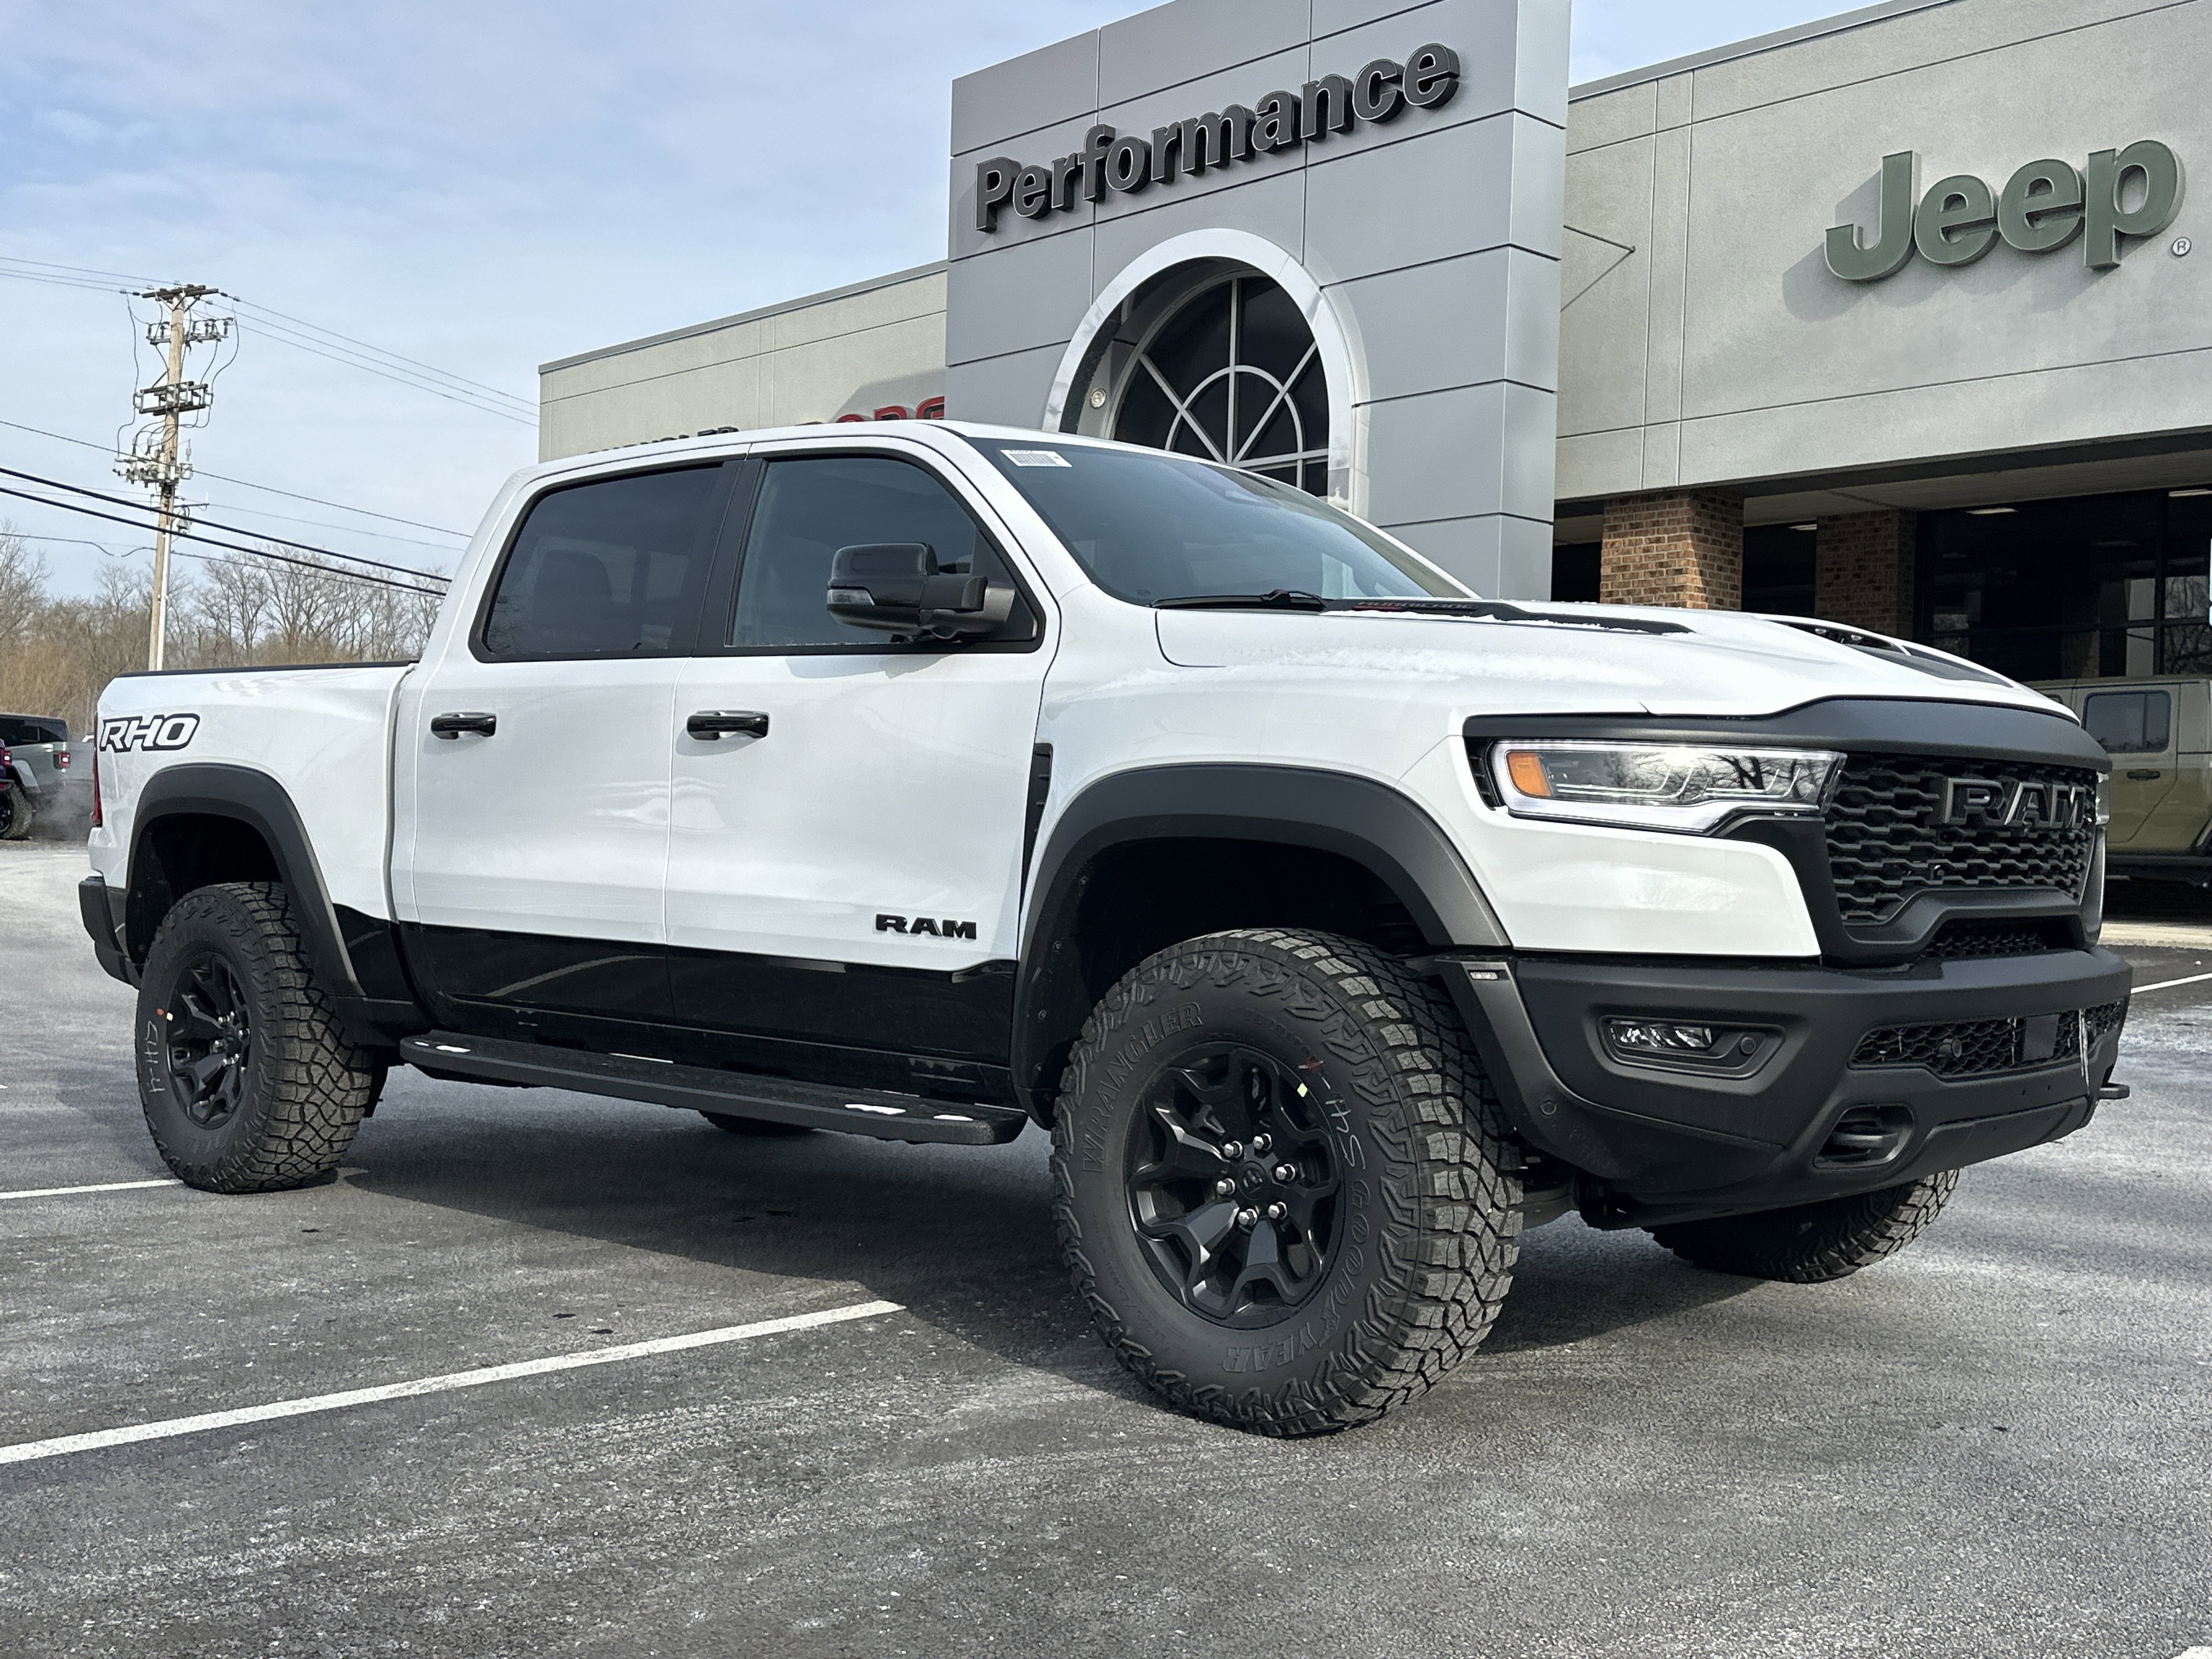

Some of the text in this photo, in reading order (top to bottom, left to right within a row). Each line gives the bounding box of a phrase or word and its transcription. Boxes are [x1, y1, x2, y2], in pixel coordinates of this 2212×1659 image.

[974, 43, 1461, 232] Performance
[1824, 139, 2186, 281] Jeep
[99, 713, 201, 753] RHO
[1942, 777, 2086, 829] RAM
[876, 913, 977, 940] RAM
[1082, 1001, 1204, 1173] WRANGLER
[1221, 1178, 1371, 1373] GOODYEAR
